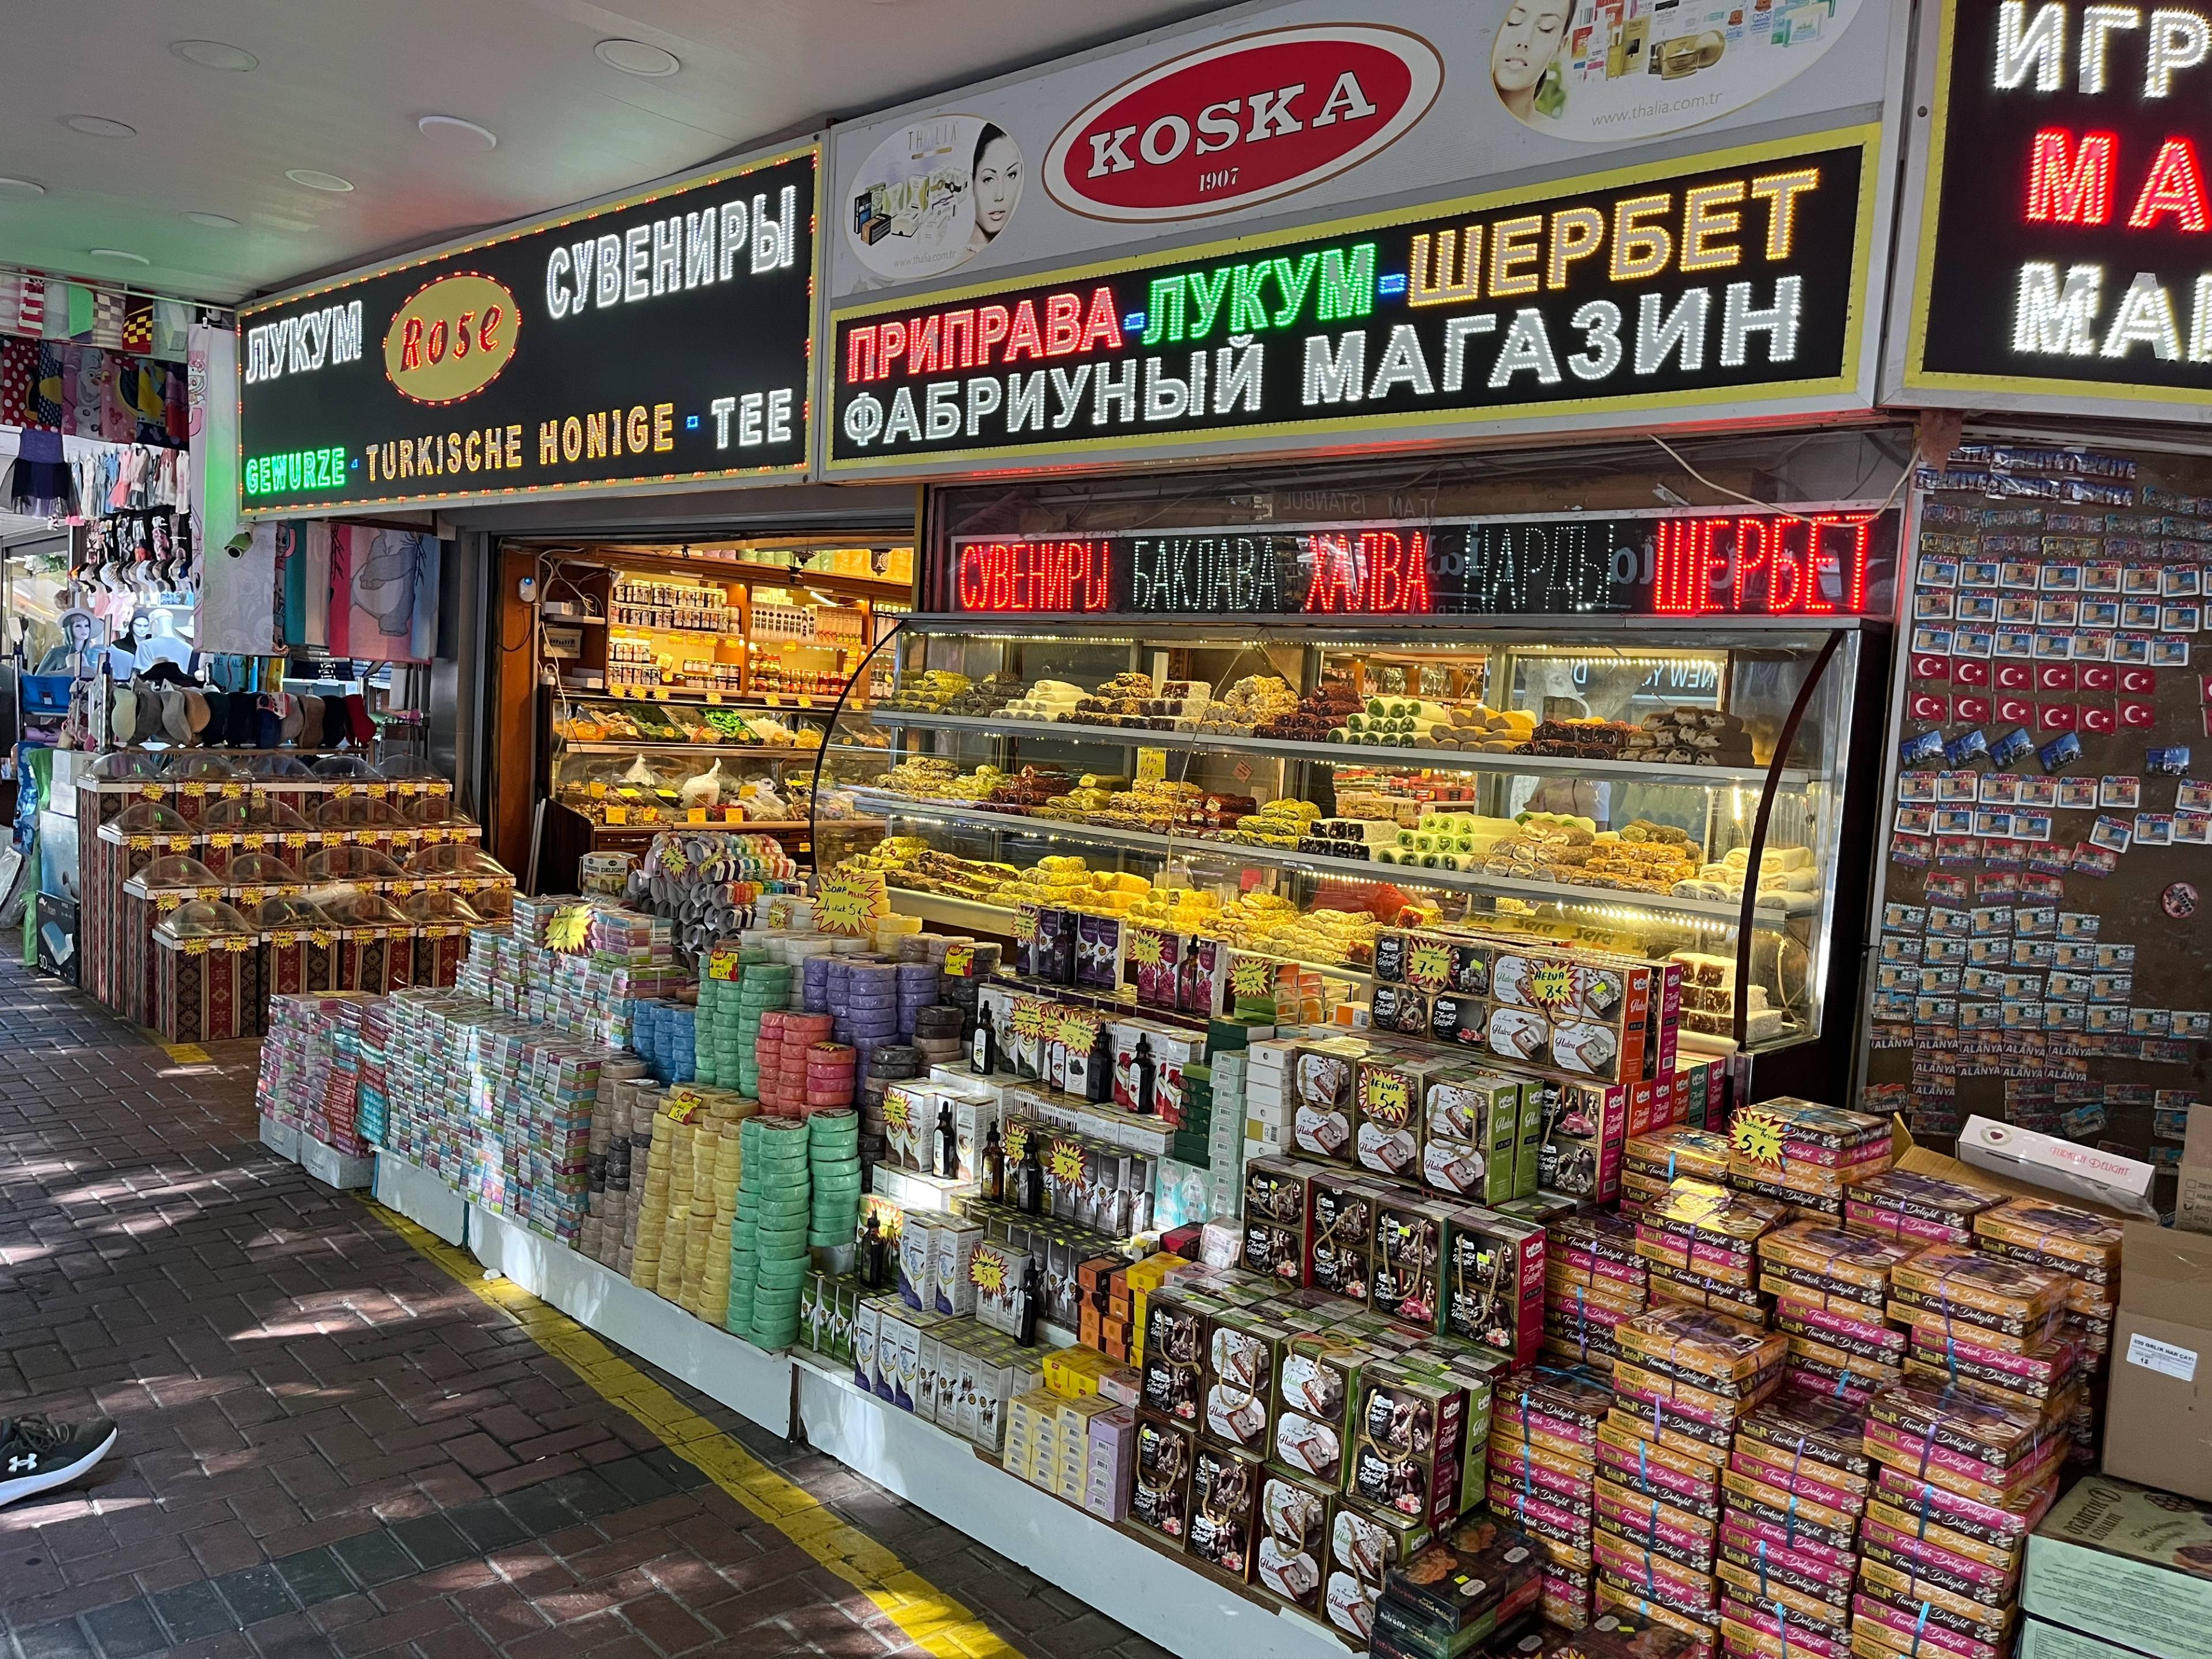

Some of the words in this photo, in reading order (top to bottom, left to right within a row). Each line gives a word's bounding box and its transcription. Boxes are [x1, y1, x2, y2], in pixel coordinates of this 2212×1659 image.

[1591, 90, 1724, 126] www.thalia.com.tr
[1086, 71, 1377, 179] KOSKA
[1198, 167, 1240, 194] 1907
[546, 184, 798, 320] СУВЕНИРЫ
[893, 251, 957, 267] www.thalia.com.tr
[245, 300, 363, 385] ЛУКУМ
[400, 303, 504, 373] Rose
[842, 334, 1264, 447] ФАБРИУНЫЙ
[1302, 275, 1803, 406] МАГАЗИН
[245, 447, 347, 495] GEWURZE
[366, 424, 522, 483] TURKISCHE
[539, 402, 674, 465] HONIGE
[710, 388, 793, 450] TEE
[960, 540, 1110, 611] СУВЕНИРЫ
[1133, 536, 1278, 611] БАКЛАВА
[1305, 530, 1429, 612] ХАЛВА
[1654, 514, 1879, 611] ШЕРБЕТ
[1571, 927, 1615, 945] Sera
[1433, 1017, 1456, 1026] Delight
[1492, 1024, 1511, 1036] Halva
[1555, 1036, 1576, 1049] Halva
[1874, 1038, 1914, 1049] ALANYA
[1919, 1039, 1959, 1049] ALANYA
[1963, 1044, 2002, 1054] ALANYA
[2006, 1044, 2045, 1057] ALANYA
[2051, 1047, 2092, 1056] ALANYA
[1915, 1063, 1956, 1074] ALANYA
[1960, 1066, 2000, 1077] ALANYA
[2003, 1067, 2043, 1078] ALANYA
[2047, 1070, 2086, 1081] ALANYA
[1915, 1085, 1955, 1095] ALANYA
[1786, 1127, 1819, 1142] Delight
[1785, 1143, 1812, 1158] Delight
[2089, 1158, 2130, 1176] DELIGHT
[1784, 1190, 1817, 1205] Delight
[1666, 1221, 1691, 1235] Turkis
[1694, 1229, 1729, 1245] Delight
[2041, 1237, 2078, 1256] Delight
[2044, 1256, 2082, 1274] Delight
[1957, 1305, 1997, 1325] Delight
[1674, 1350, 1706, 1368] Delight
[1983, 1351, 2023, 1369] Delight
[1674, 1366, 1710, 1384] Delight
[1544, 1403, 1575, 1420] Delight
[1935, 1430, 1978, 1452] Delight
[1804, 1442, 1842, 1463] Delight
[1538, 1521, 1570, 1539] Delight
[1654, 1522, 1687, 1543] Delight
[1786, 1518, 1824, 1537] Delight
[1942, 1513, 1984, 1535] Delight
[1654, 1539, 1685, 1559] Delight
[1933, 1552, 1976, 1574] Delight
[1927, 1569, 1968, 1591] Delight
[1929, 1607, 1971, 1630] Delight
